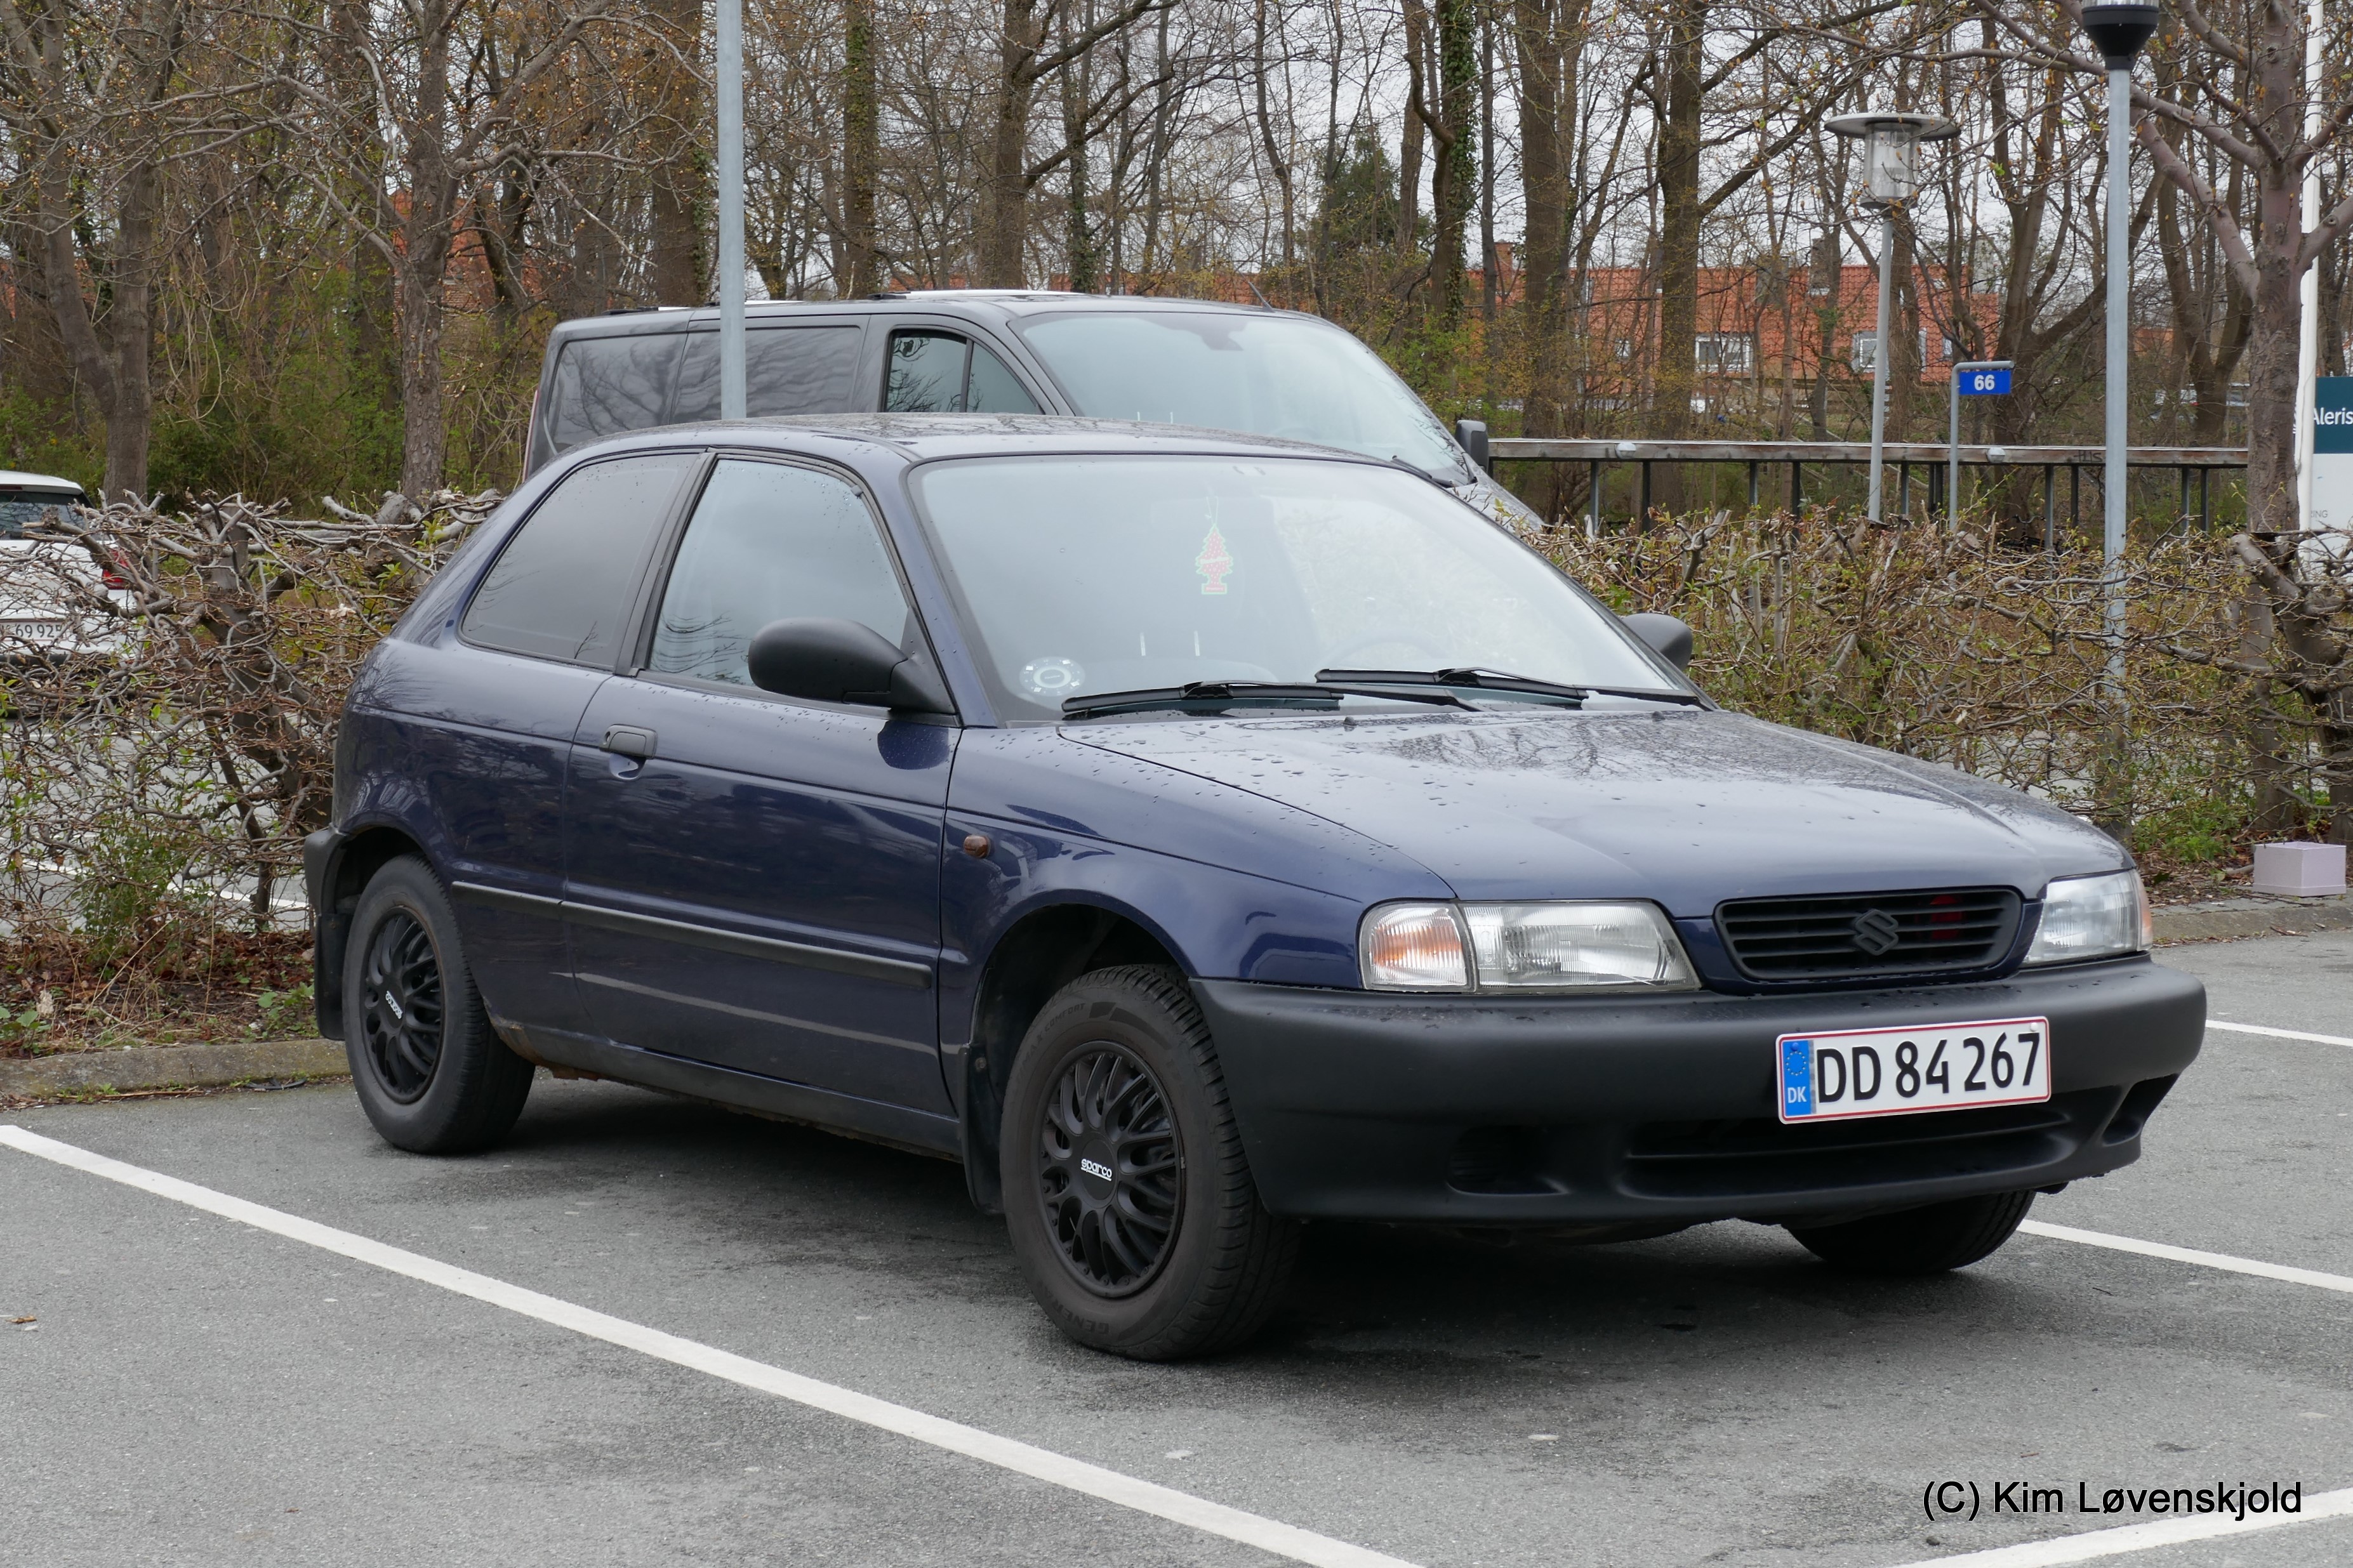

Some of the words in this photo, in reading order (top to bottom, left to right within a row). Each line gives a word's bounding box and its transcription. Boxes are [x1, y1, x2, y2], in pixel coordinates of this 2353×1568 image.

[1974, 374, 1995, 391] 66
[1044, 1003, 1085, 1032] COMFORT
[1816, 1046, 1881, 1103] DD
[1895, 1039, 1949, 1098] 84
[1963, 1032, 2040, 1091] 267
[1787, 1086, 1807, 1104] DK
[1081, 1158, 1112, 1179] sparco
